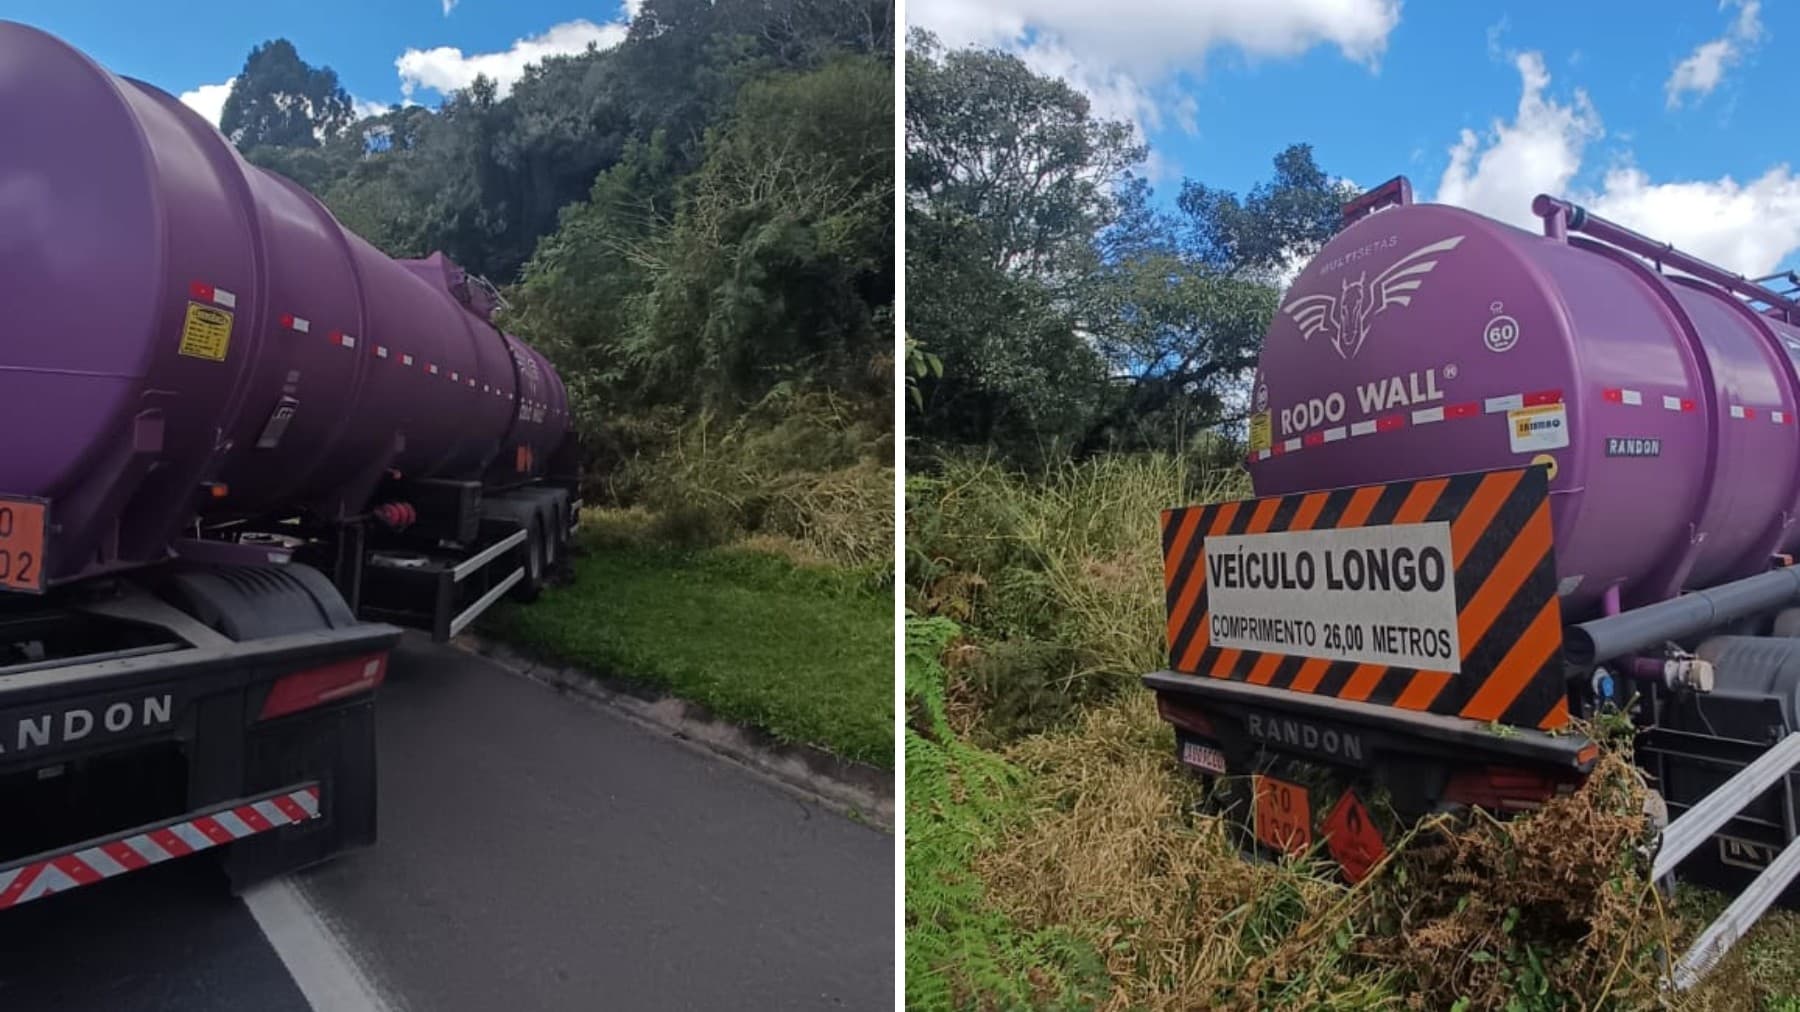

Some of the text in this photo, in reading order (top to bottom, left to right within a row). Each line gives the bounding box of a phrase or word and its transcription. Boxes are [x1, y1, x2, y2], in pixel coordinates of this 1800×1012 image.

[1490, 325, 1513, 342] 60
[1281, 392, 1346, 435] RODO
[1609, 438, 1660, 456] RANDON
[1208, 545, 1446, 593] VEÍCULO LONGO
[1212, 614, 1452, 659] COMPRIMENTO 26,00 METROS
[0, 694, 173, 751] NDON
[1250, 713, 1363, 761] RANDON
